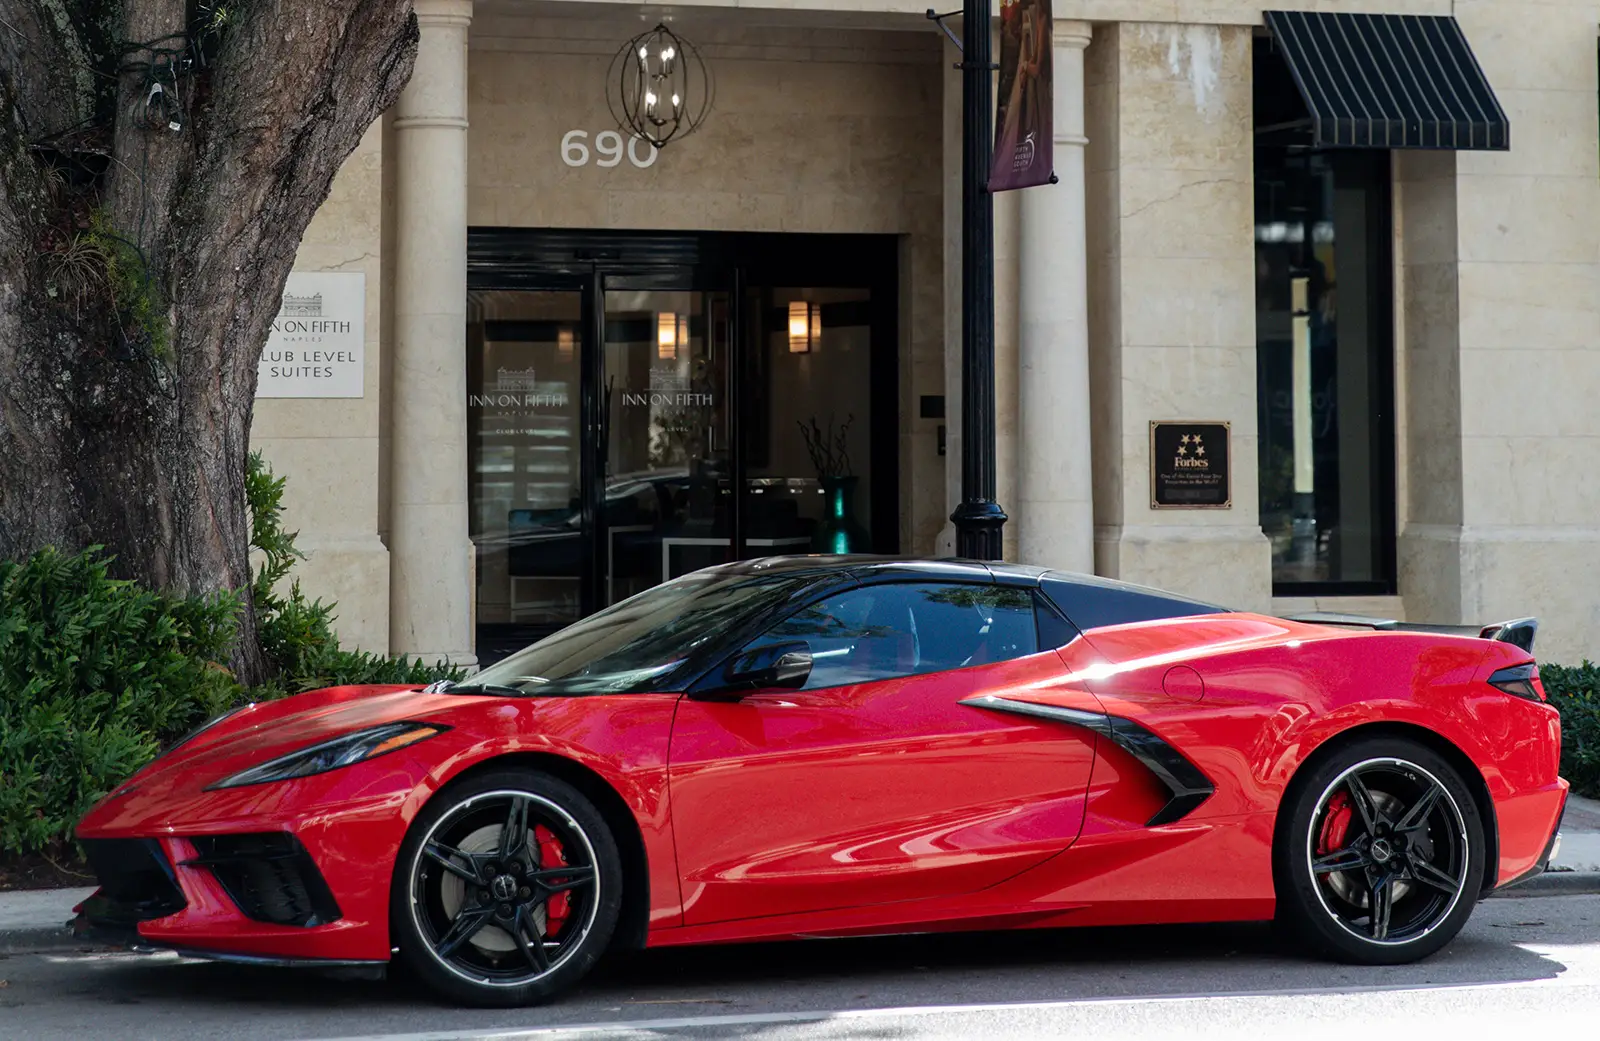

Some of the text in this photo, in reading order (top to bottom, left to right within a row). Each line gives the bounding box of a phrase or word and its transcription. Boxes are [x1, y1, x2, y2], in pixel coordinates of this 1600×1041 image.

[561, 130, 658, 168] 690
[284, 320, 308, 333] ON
[312, 320, 350, 333] FIFTH
[261, 351, 356, 362] LUB LEVEL
[270, 366, 333, 378] SUITES
[469, 394, 562, 407] INN ON FIFTH
[622, 393, 713, 406] INN ON FIFTH
[1174, 457, 1209, 467] Forbes
